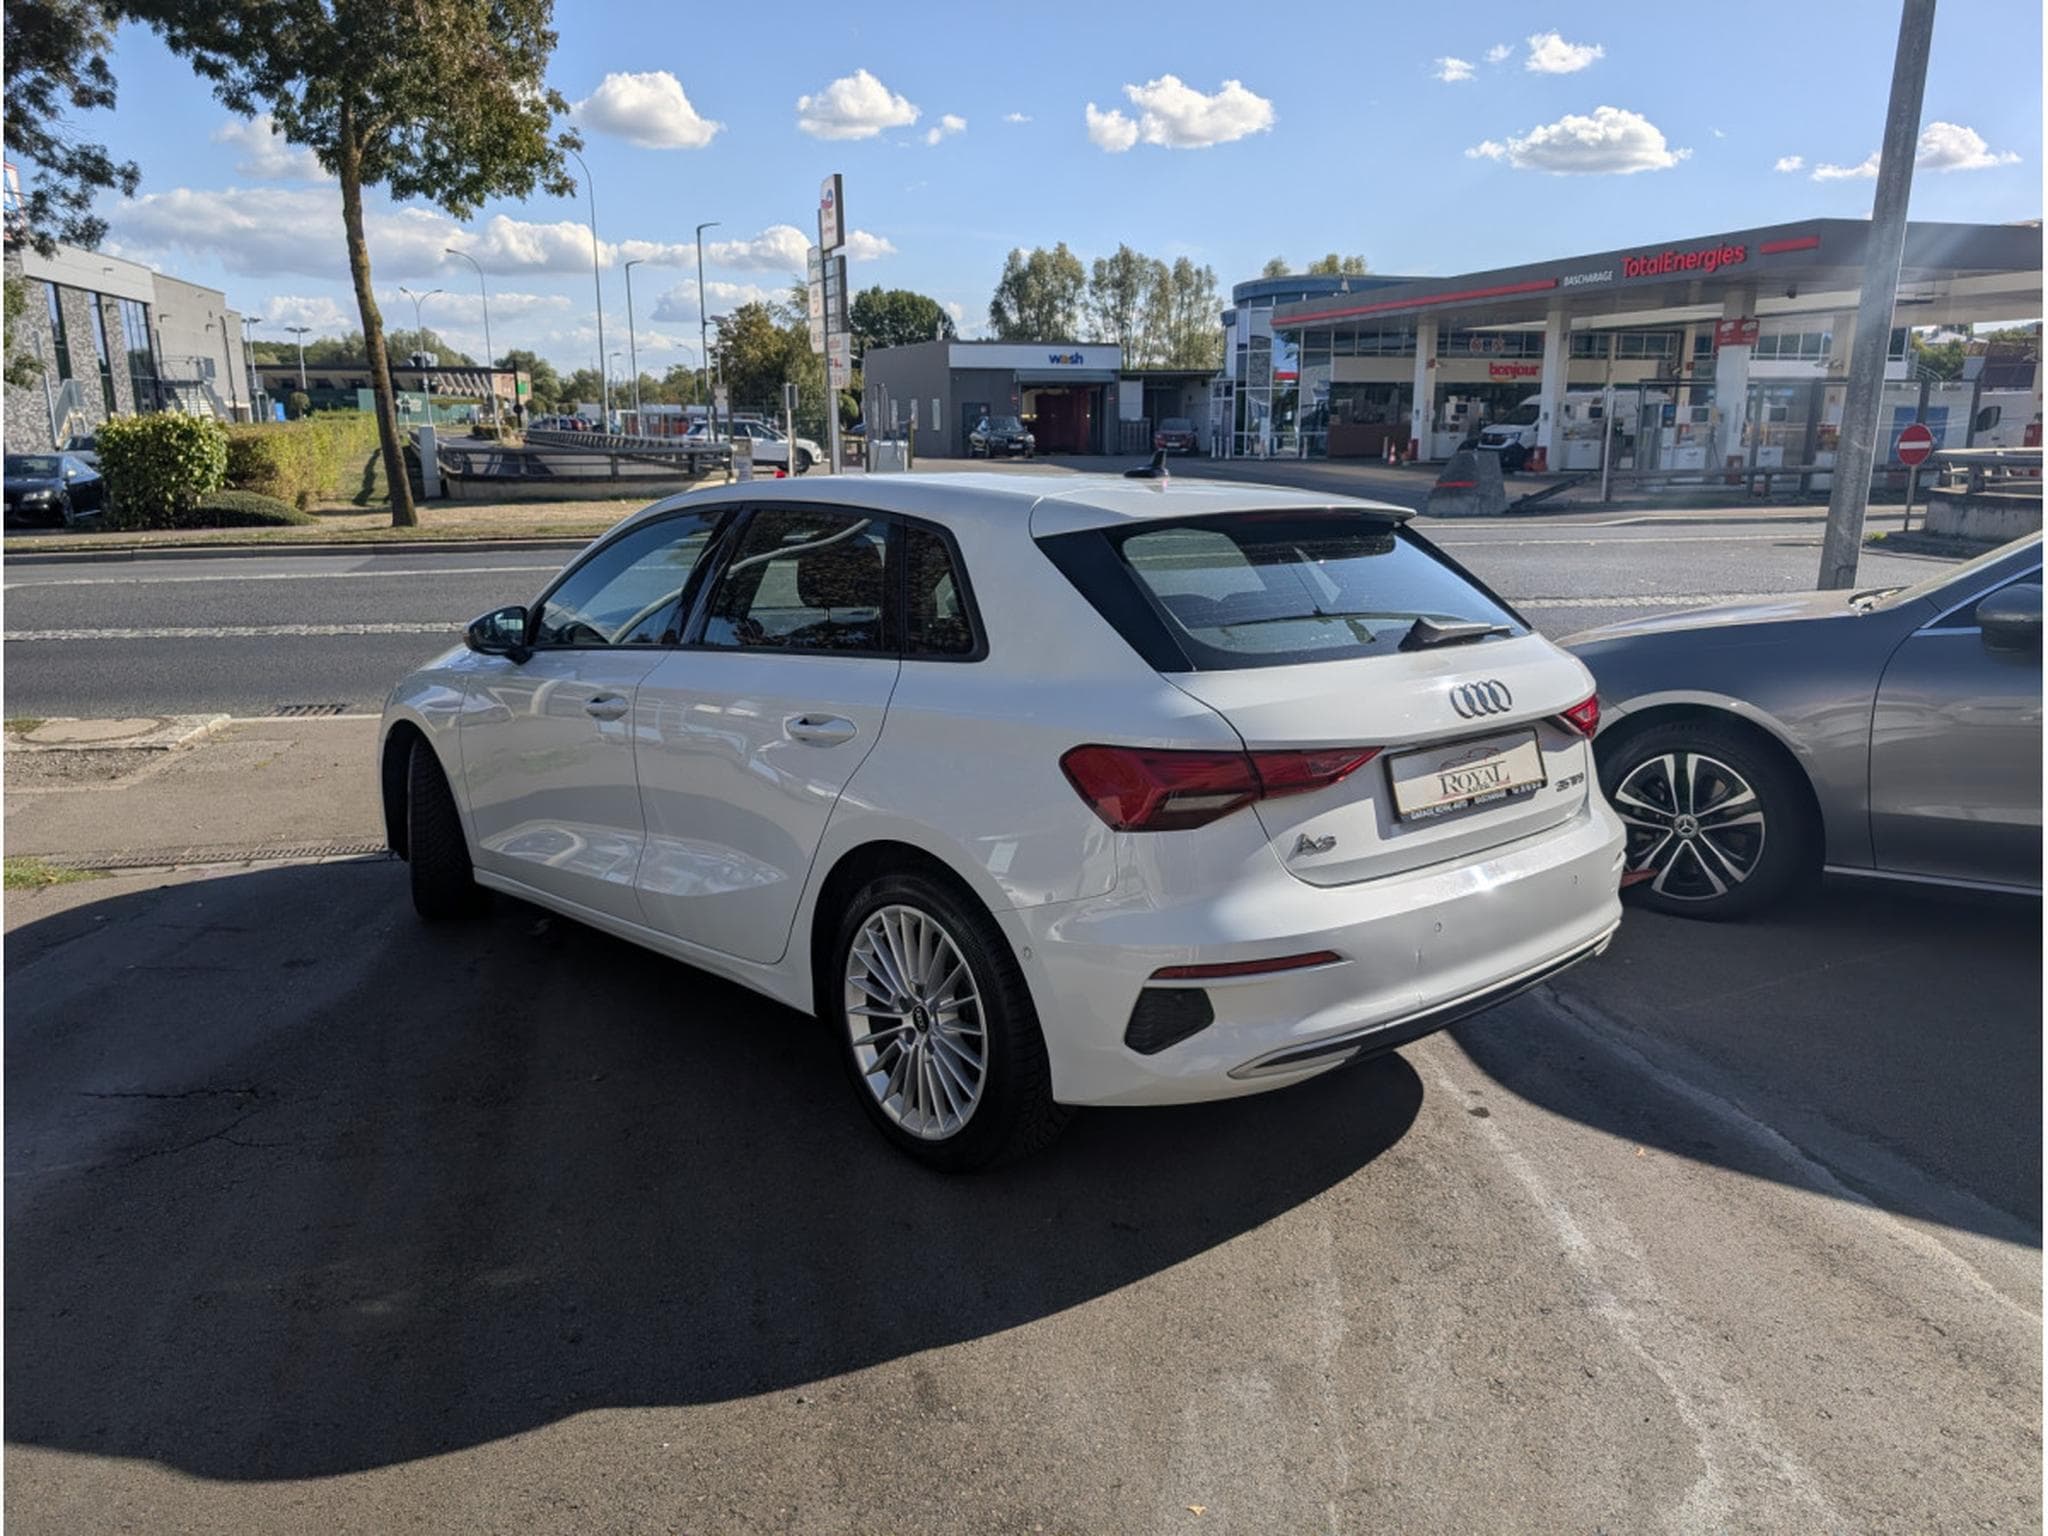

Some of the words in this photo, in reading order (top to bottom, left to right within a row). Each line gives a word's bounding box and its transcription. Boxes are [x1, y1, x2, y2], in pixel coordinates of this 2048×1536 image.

[1621, 243, 1747, 279] TotalEnergies
[1563, 270, 1614, 287] BASCHARAGE
[1048, 352, 1084, 365] wash
[1488, 362, 1540, 379] bonjour
[1437, 761, 1510, 796] ROYAL
[1297, 833, 1337, 853] A3
